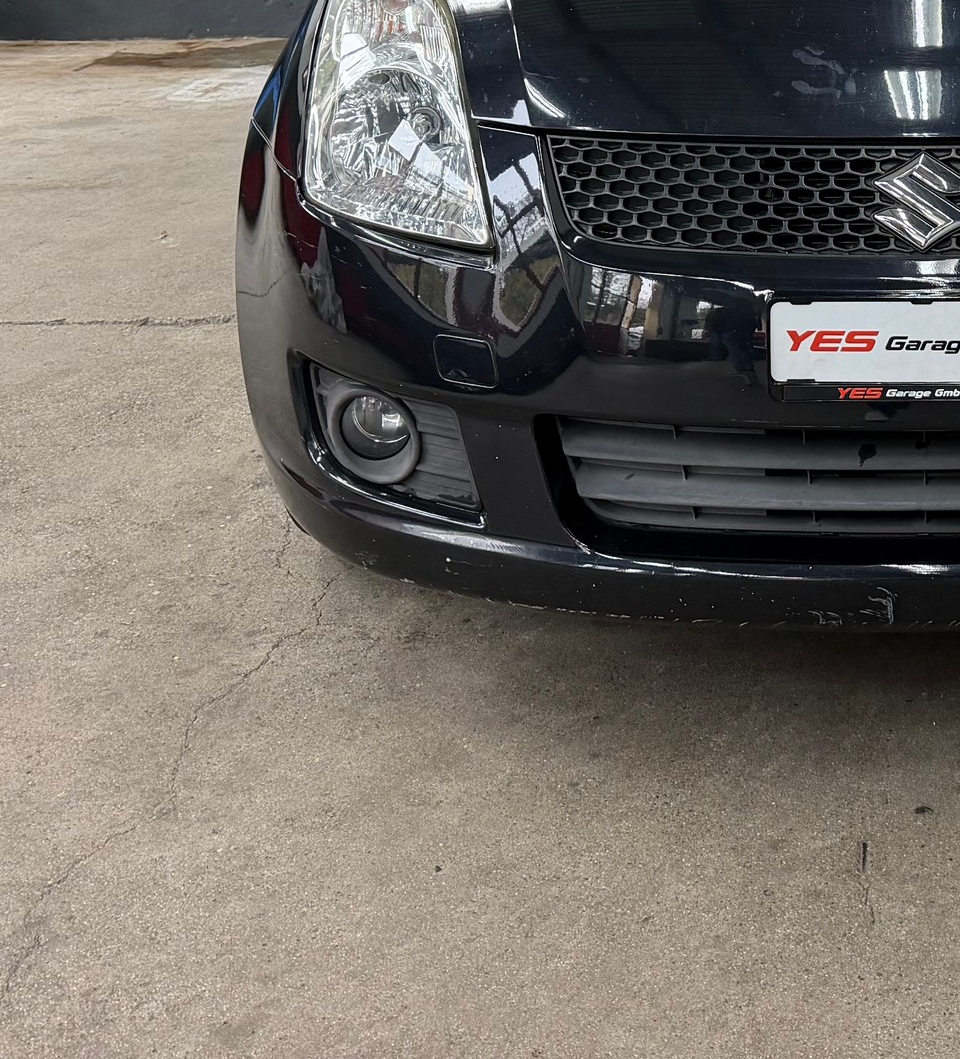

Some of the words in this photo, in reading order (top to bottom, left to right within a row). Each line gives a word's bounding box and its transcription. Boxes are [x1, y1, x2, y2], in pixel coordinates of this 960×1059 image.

[786, 330, 879, 352] YES
[837, 387, 884, 399] YES
[885, 388, 932, 399] Garage
